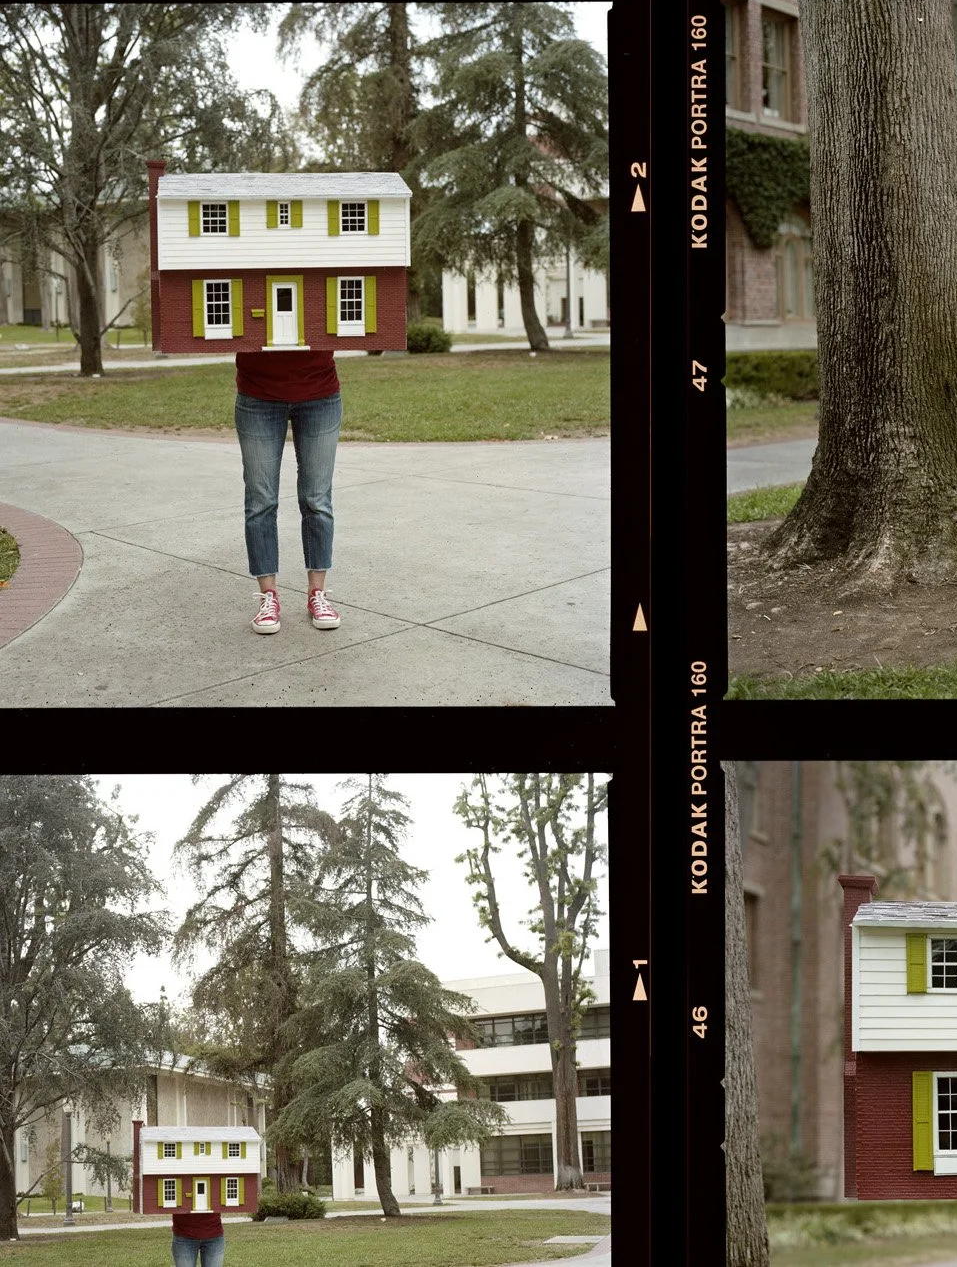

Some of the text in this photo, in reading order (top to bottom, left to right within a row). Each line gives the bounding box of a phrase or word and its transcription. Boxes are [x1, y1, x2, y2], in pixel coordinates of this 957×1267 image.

[690, 14, 708, 249] KODAK PORTRA 160
[630, 162, 647, 179] 2
[692, 359, 708, 392] 47
[690, 660, 708, 894] KODAK PORTRA 160
[632, 959, 648, 969] 1
[691, 1005, 708, 1039] 46
